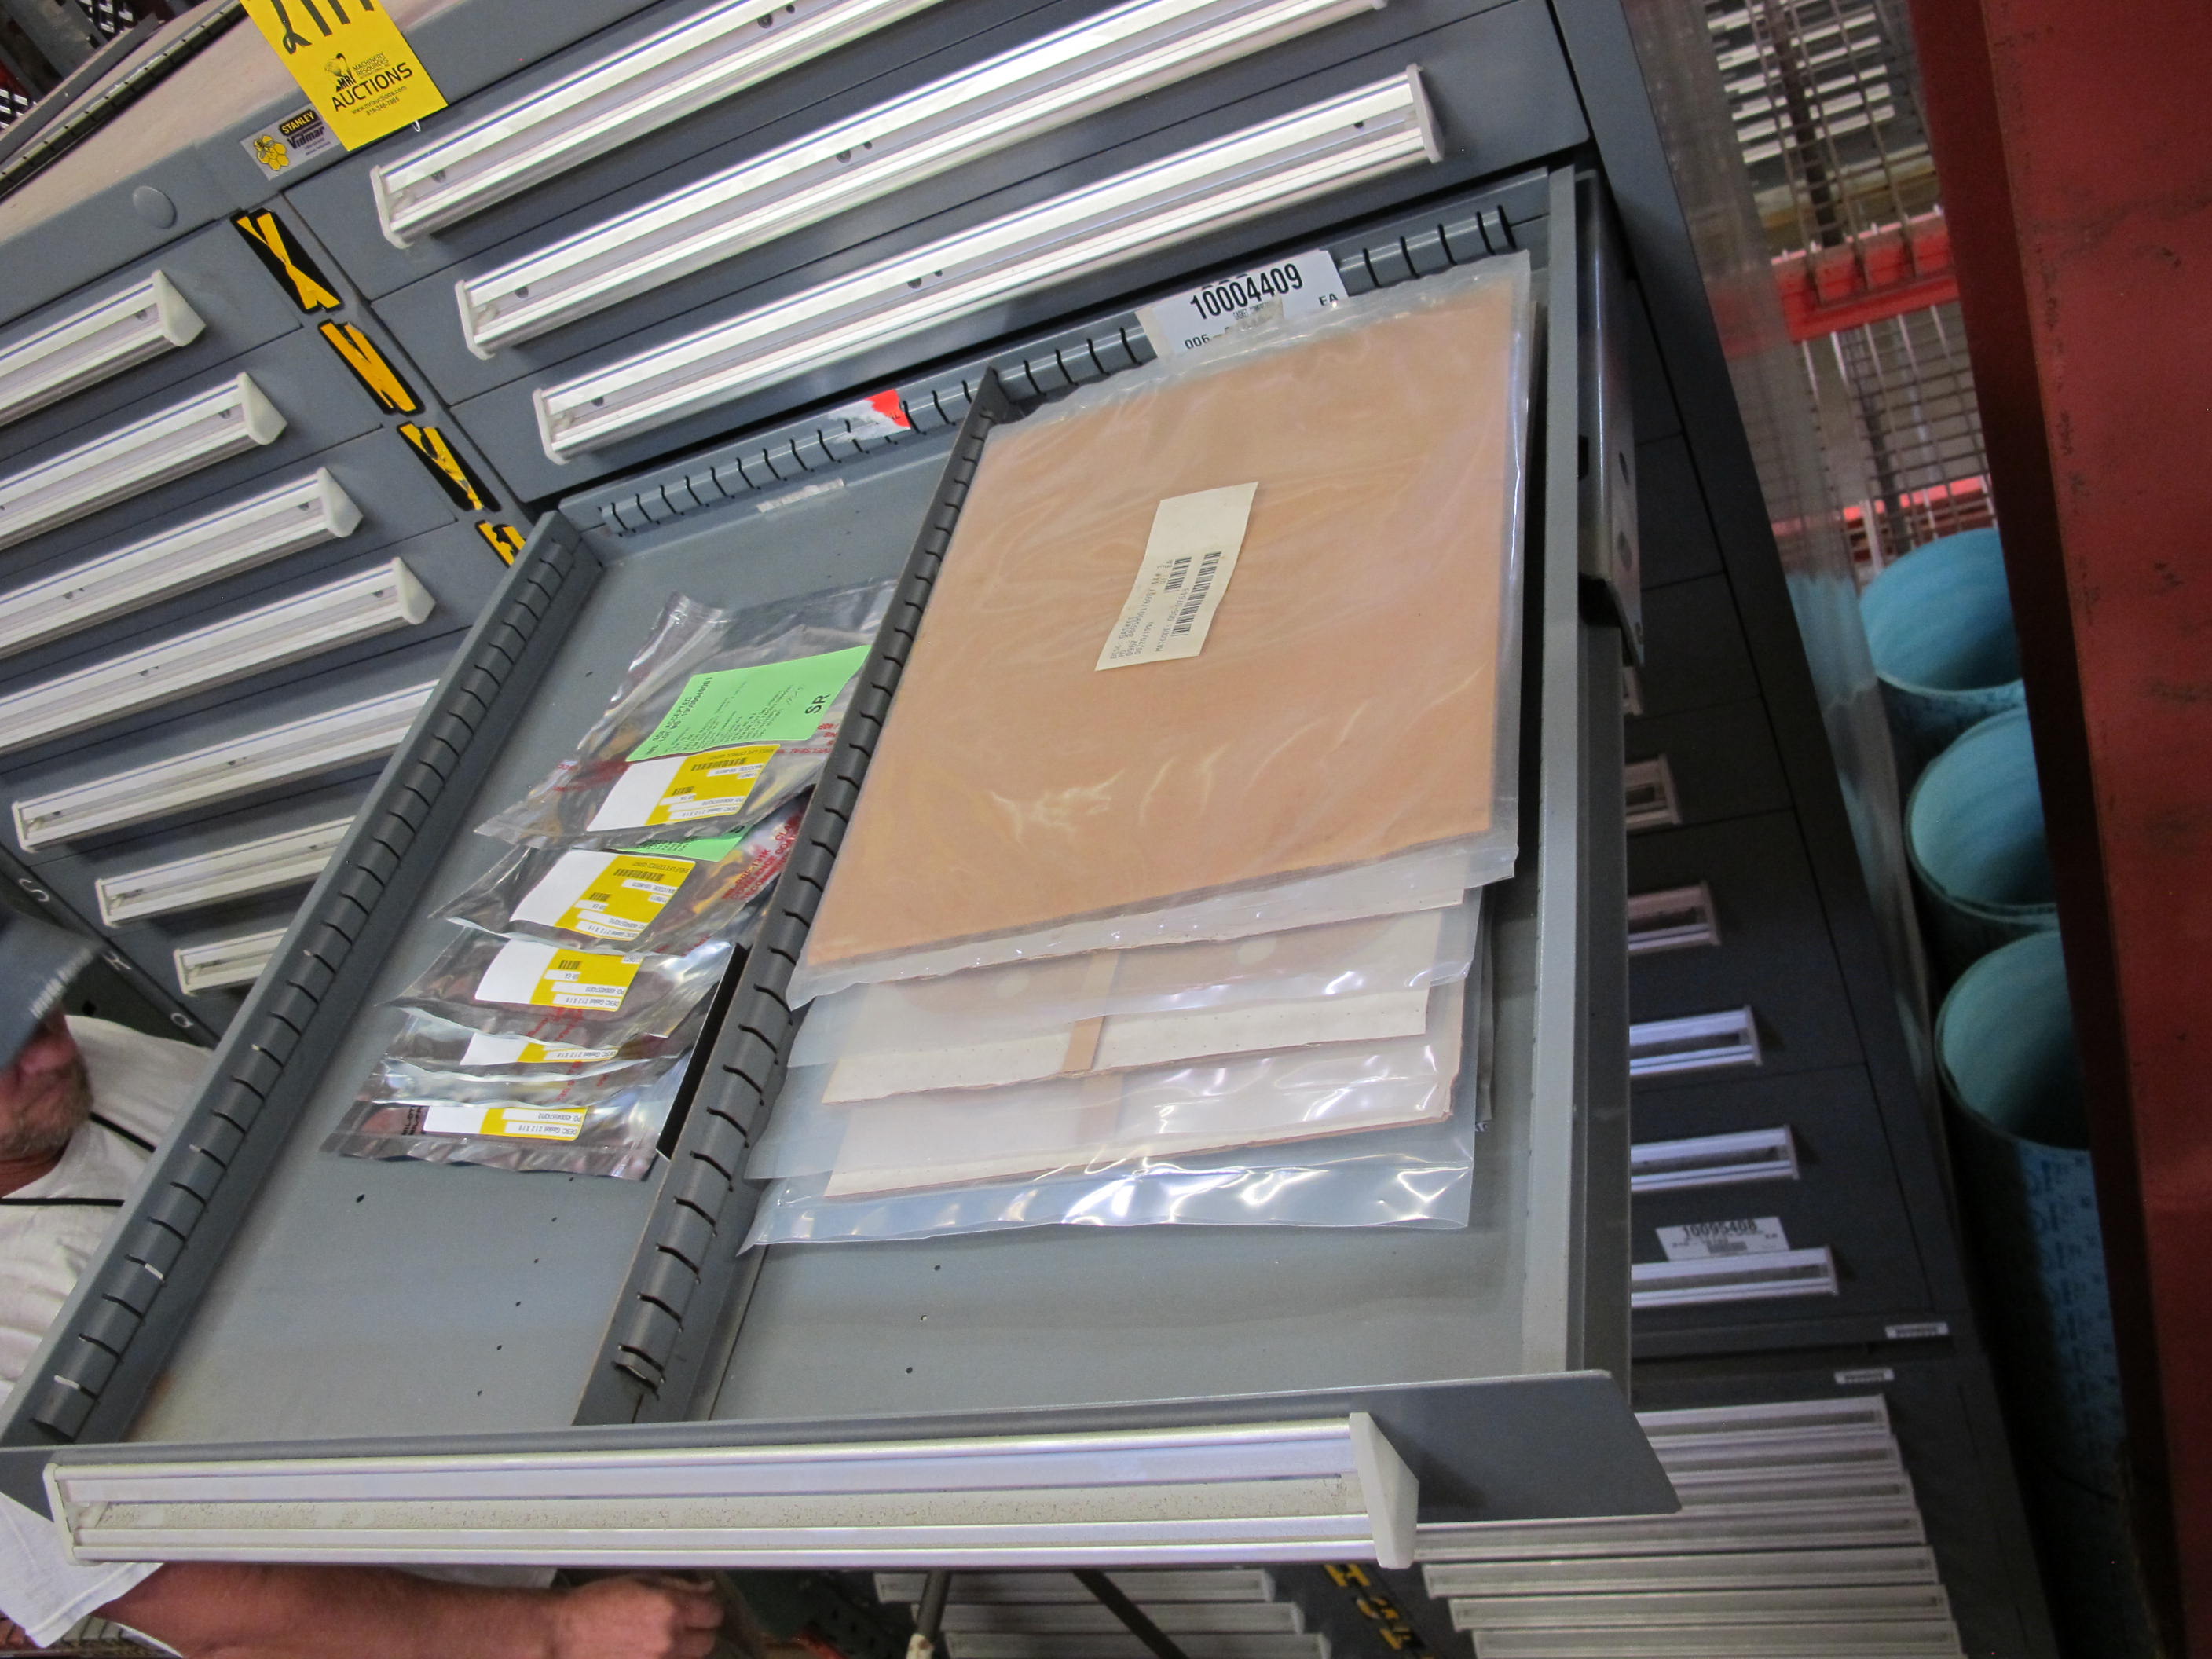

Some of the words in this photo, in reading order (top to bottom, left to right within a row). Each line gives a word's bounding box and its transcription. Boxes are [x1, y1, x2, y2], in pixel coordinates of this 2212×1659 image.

[331, 62, 413, 112] AUCTIONS
[281, 111, 316, 134] STANLEY
[287, 126, 325, 149] Vidmar
[1190, 263, 1304, 320] 10004409
[1184, 333, 1210, 350] 006
[804, 694, 831, 715] SR
